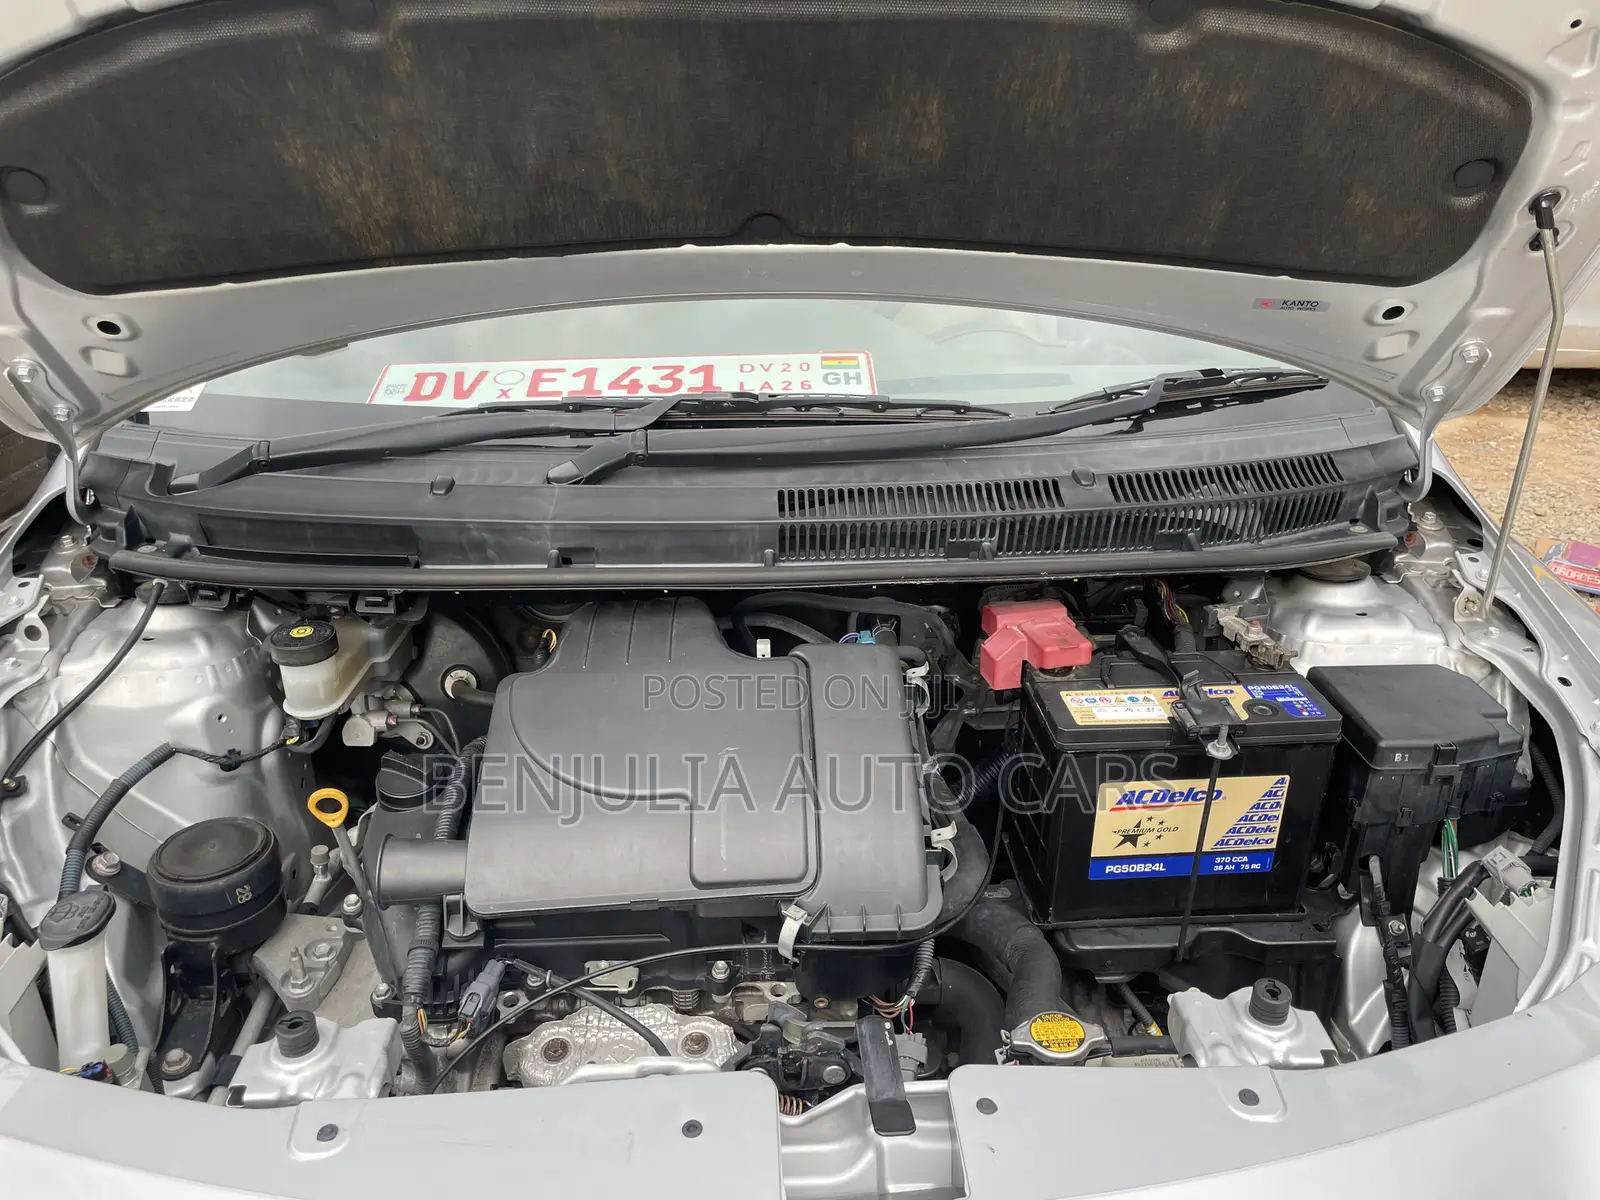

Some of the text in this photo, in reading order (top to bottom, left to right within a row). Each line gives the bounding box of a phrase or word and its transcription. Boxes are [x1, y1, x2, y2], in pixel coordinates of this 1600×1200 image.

[1281, 299, 1320, 308] KANTO
[403, 370, 489, 401] DV
[526, 364, 722, 397] E1431
[822, 372, 862, 386] GH
[1273, 777, 1286, 785] A
[1115, 787, 1223, 805] ACDelco
[1261, 789, 1284, 798] AC
[1249, 801, 1282, 810] ACD
[1117, 827, 1155, 835] PREMIUM
[1225, 825, 1277, 834] ACDelc
[1213, 837, 1275, 846] ACDelco
[1105, 863, 1166, 874] PG50B24L
